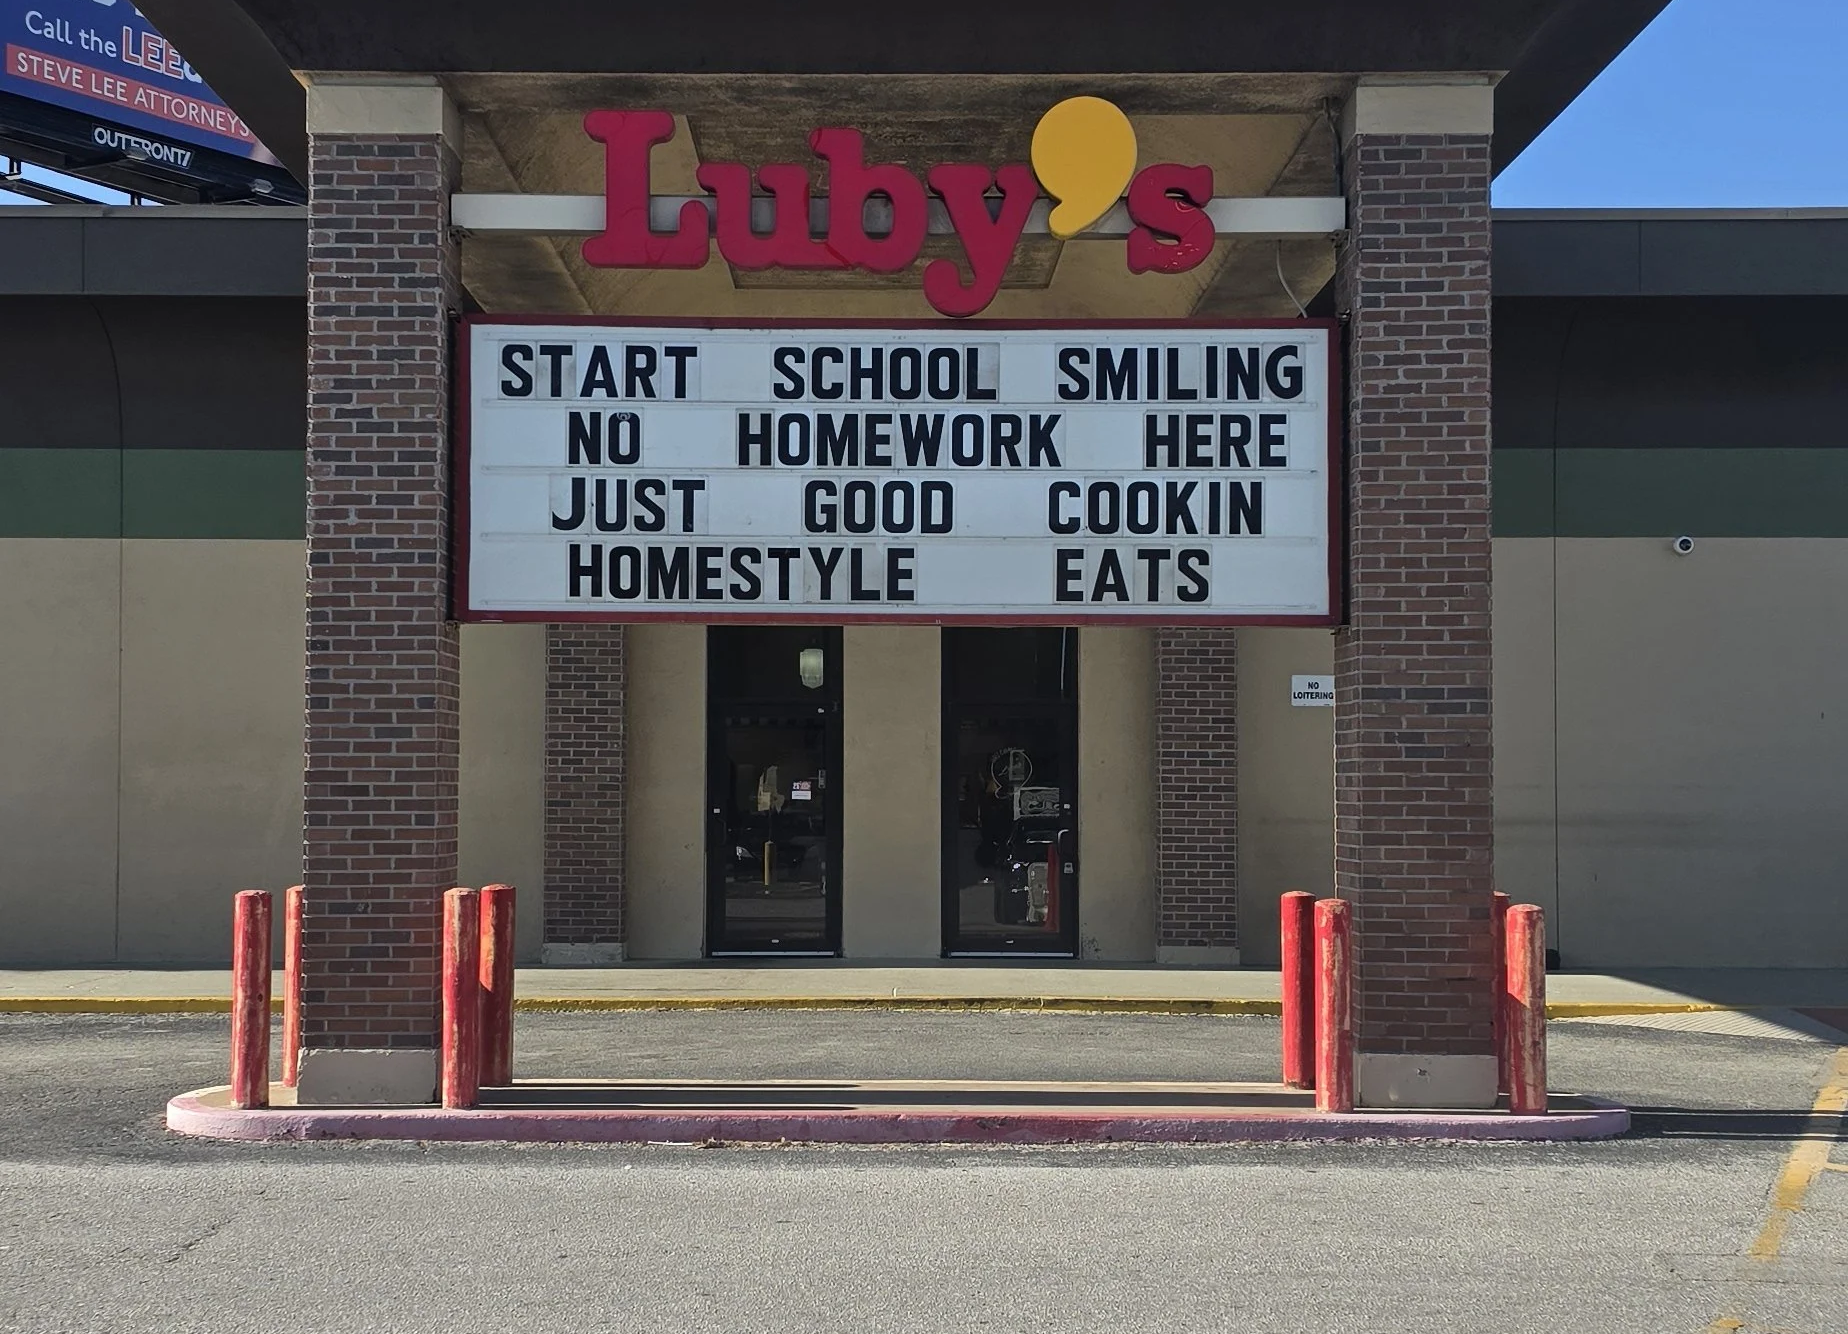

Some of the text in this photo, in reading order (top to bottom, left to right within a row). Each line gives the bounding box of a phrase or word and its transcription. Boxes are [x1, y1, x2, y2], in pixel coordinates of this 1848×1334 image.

[25, 10, 73, 45] Call
[78, 28, 117, 58] the
[17, 52, 250, 137] STEVE LEE ATTORNEYS
[582, 97, 1215, 316] Luby's
[501, 344, 1303, 401] START SCHOOL SMILING
[568, 411, 1287, 468] NO HOMEWORK HERE
[551, 476, 1263, 536] JUST GOOD COOKIN
[569, 543, 1210, 603] HOMESTYLE EATS
[1293, 691, 1334, 699] LOITERING
[1307, 681, 1320, 690] NO
